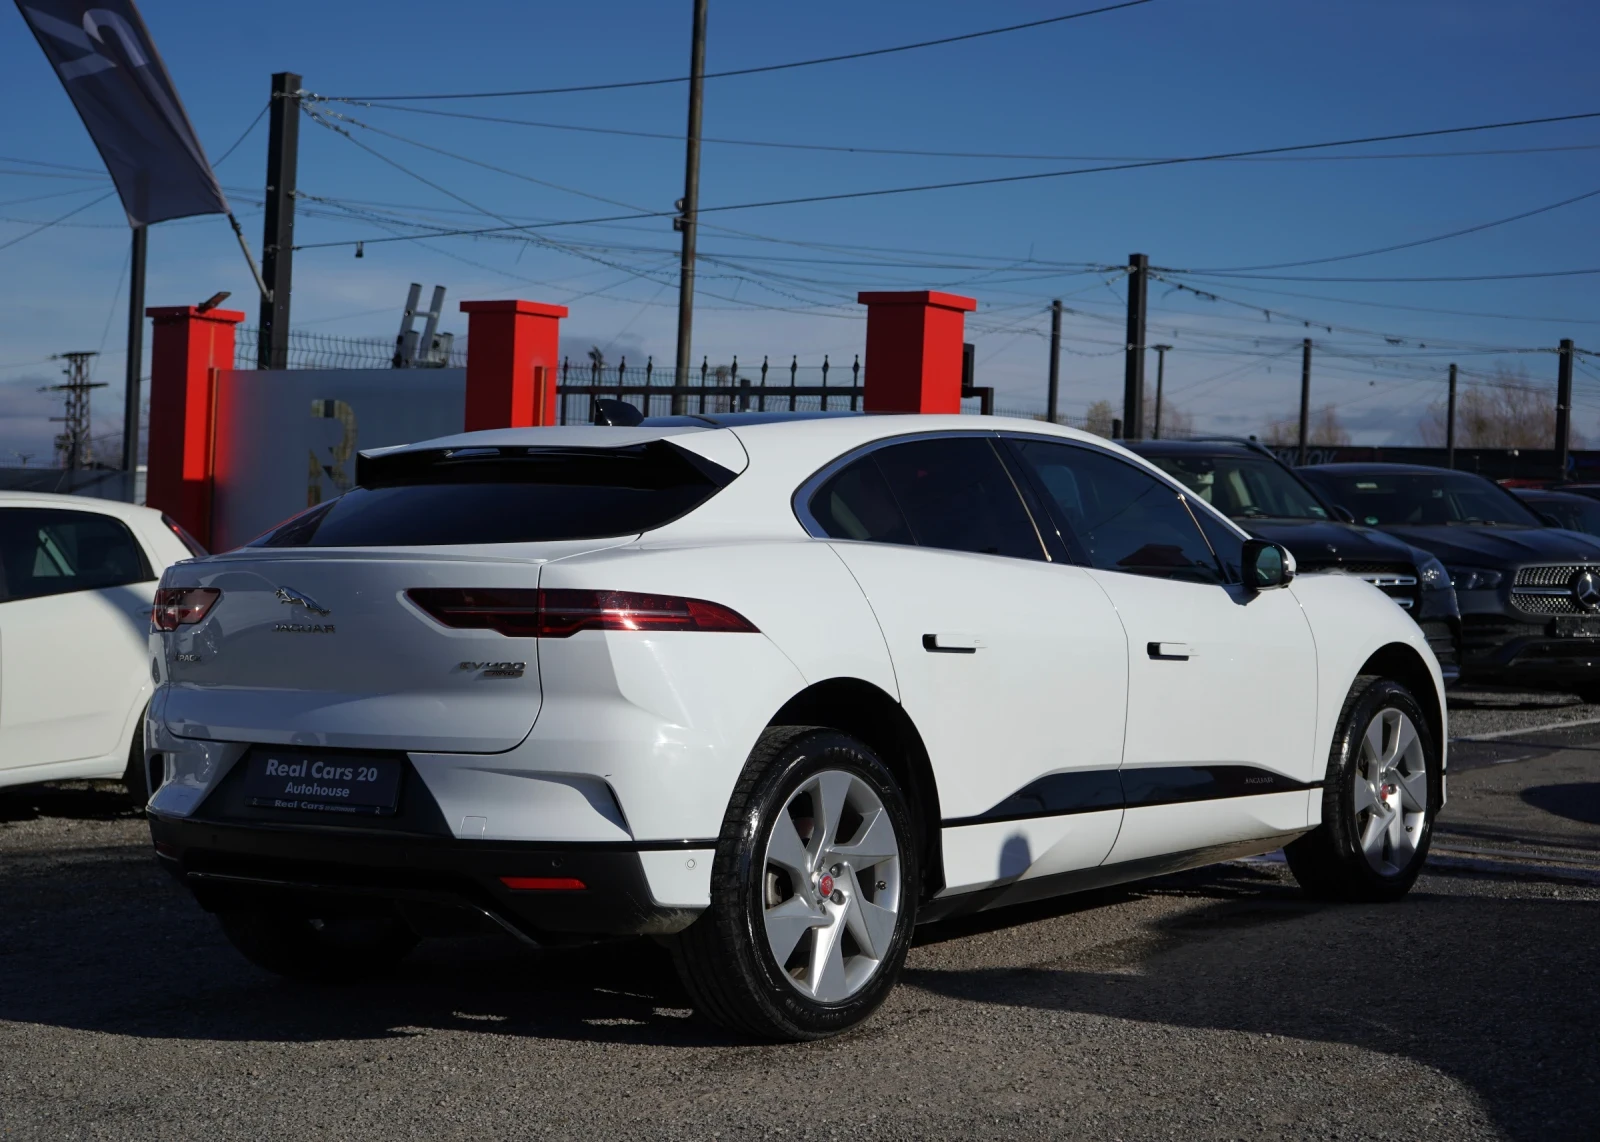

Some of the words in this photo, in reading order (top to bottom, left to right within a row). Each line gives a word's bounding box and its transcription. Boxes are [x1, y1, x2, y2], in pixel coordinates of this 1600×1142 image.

[271, 623, 336, 634] JAGUAR
[265, 758, 308, 778] Real
[311, 761, 353, 781] Cars
[356, 767, 378, 782] 20
[1243, 776, 1274, 785] JAGUAR
[284, 781, 350, 798] Autohouse
[274, 799, 298, 809] Real
[300, 801, 325, 811] Cars
